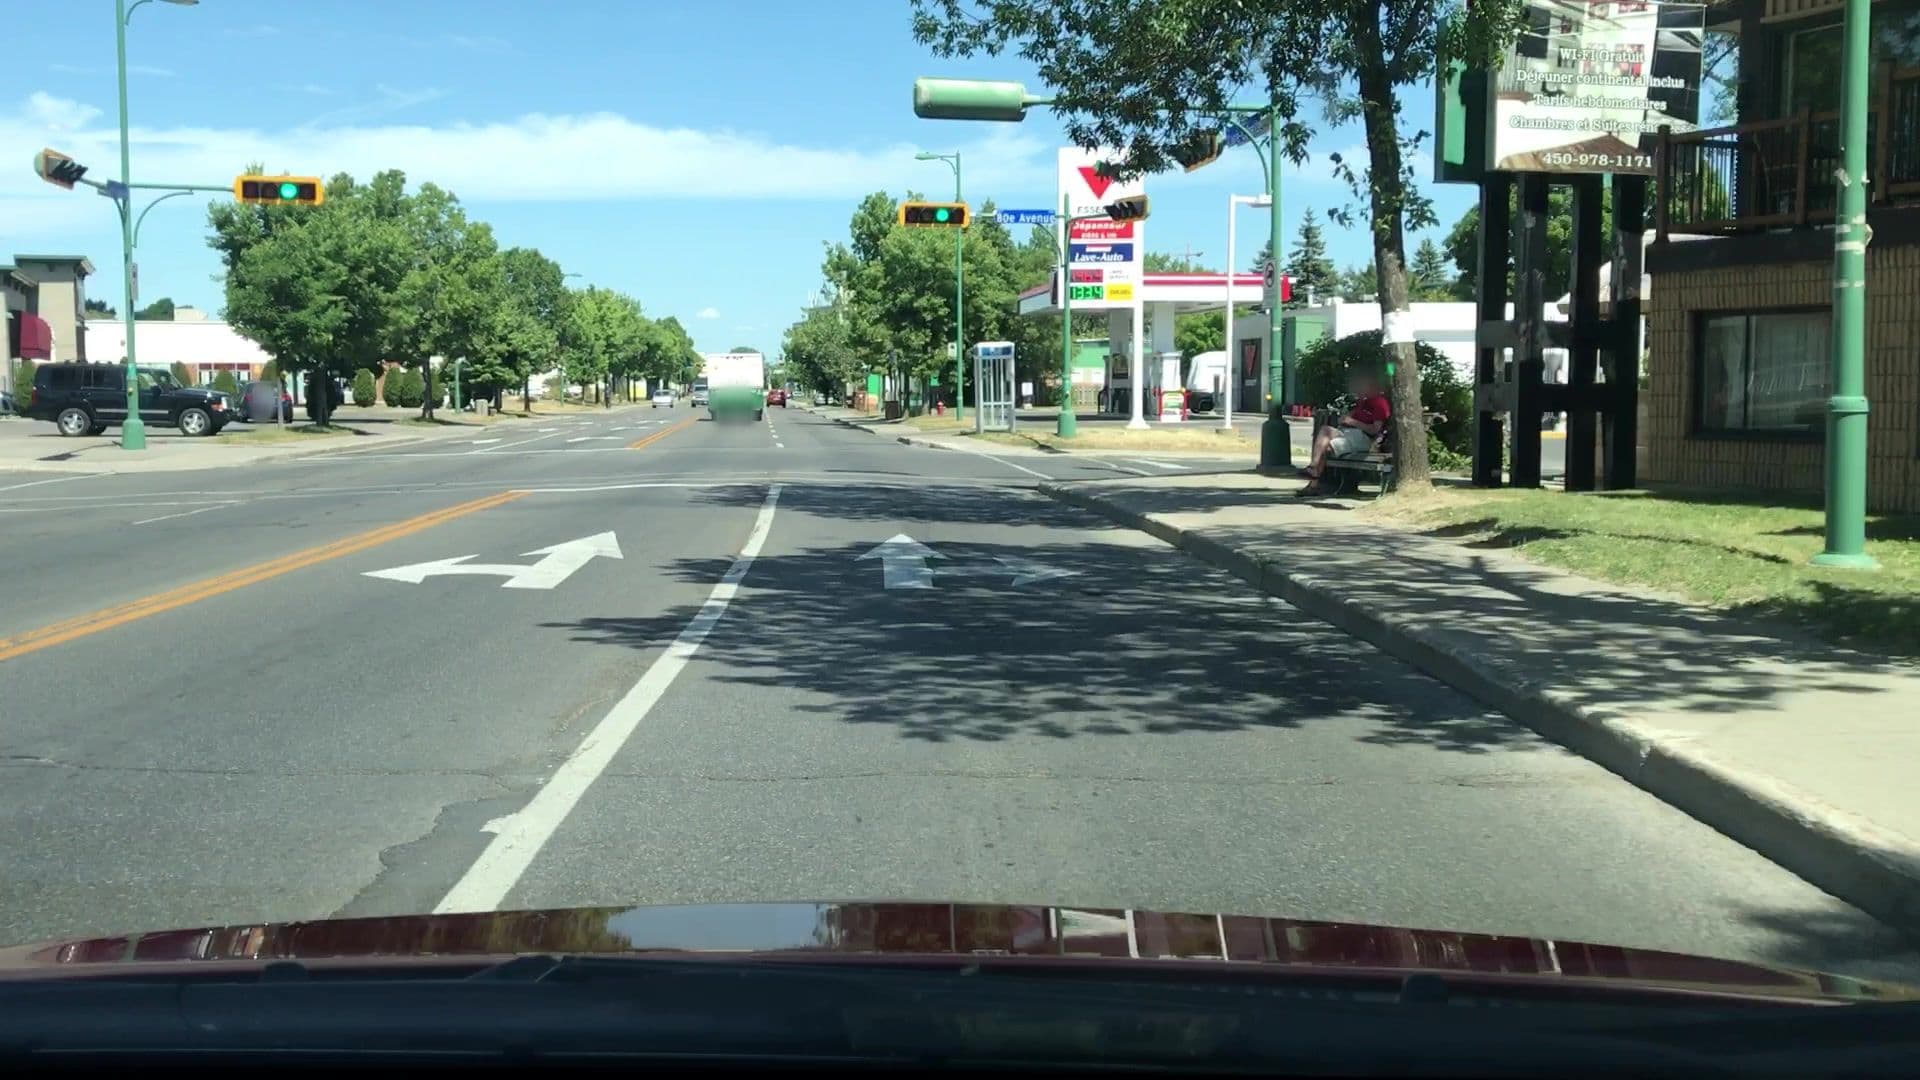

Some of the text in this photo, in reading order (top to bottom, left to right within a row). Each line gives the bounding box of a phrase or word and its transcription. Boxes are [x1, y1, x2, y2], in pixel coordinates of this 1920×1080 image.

[1600, 50, 1644, 62] Gratuit
[1516, 70, 1686, 88] Déjeuner continental inclus
[1533, 95, 1668, 110] Tarifs hebdomadaires
[1510, 115, 1574, 129] Chambres
[1578, 119, 1588, 130] et
[1592, 118, 1634, 133] Suites
[1542, 152, 1652, 167] 450-978-1171
[1019, 214, 1056, 223] Avenue
[1075, 252, 1124, 262] Lave-Auto
